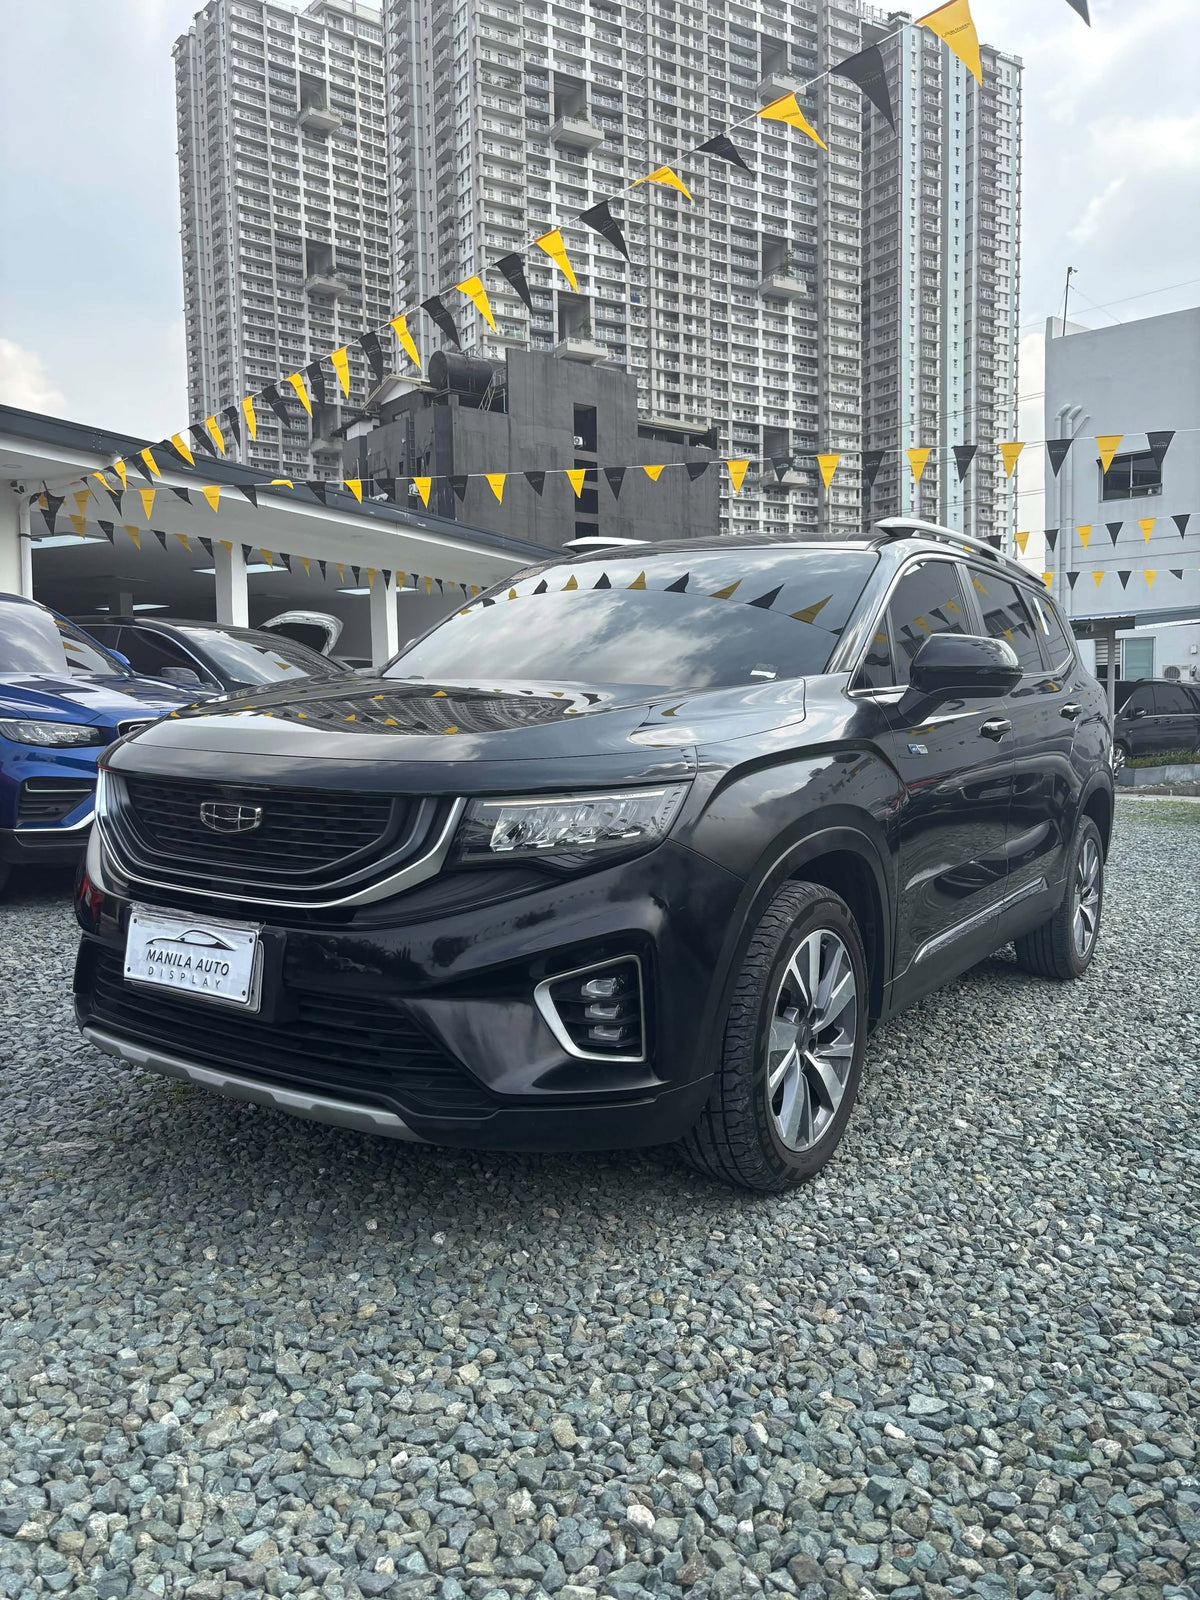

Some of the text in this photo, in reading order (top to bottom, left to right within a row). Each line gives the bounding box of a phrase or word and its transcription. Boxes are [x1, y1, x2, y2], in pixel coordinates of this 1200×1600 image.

[146, 949, 230, 976] MANILA AUTO
[148, 967, 221, 989] DISPLAY
